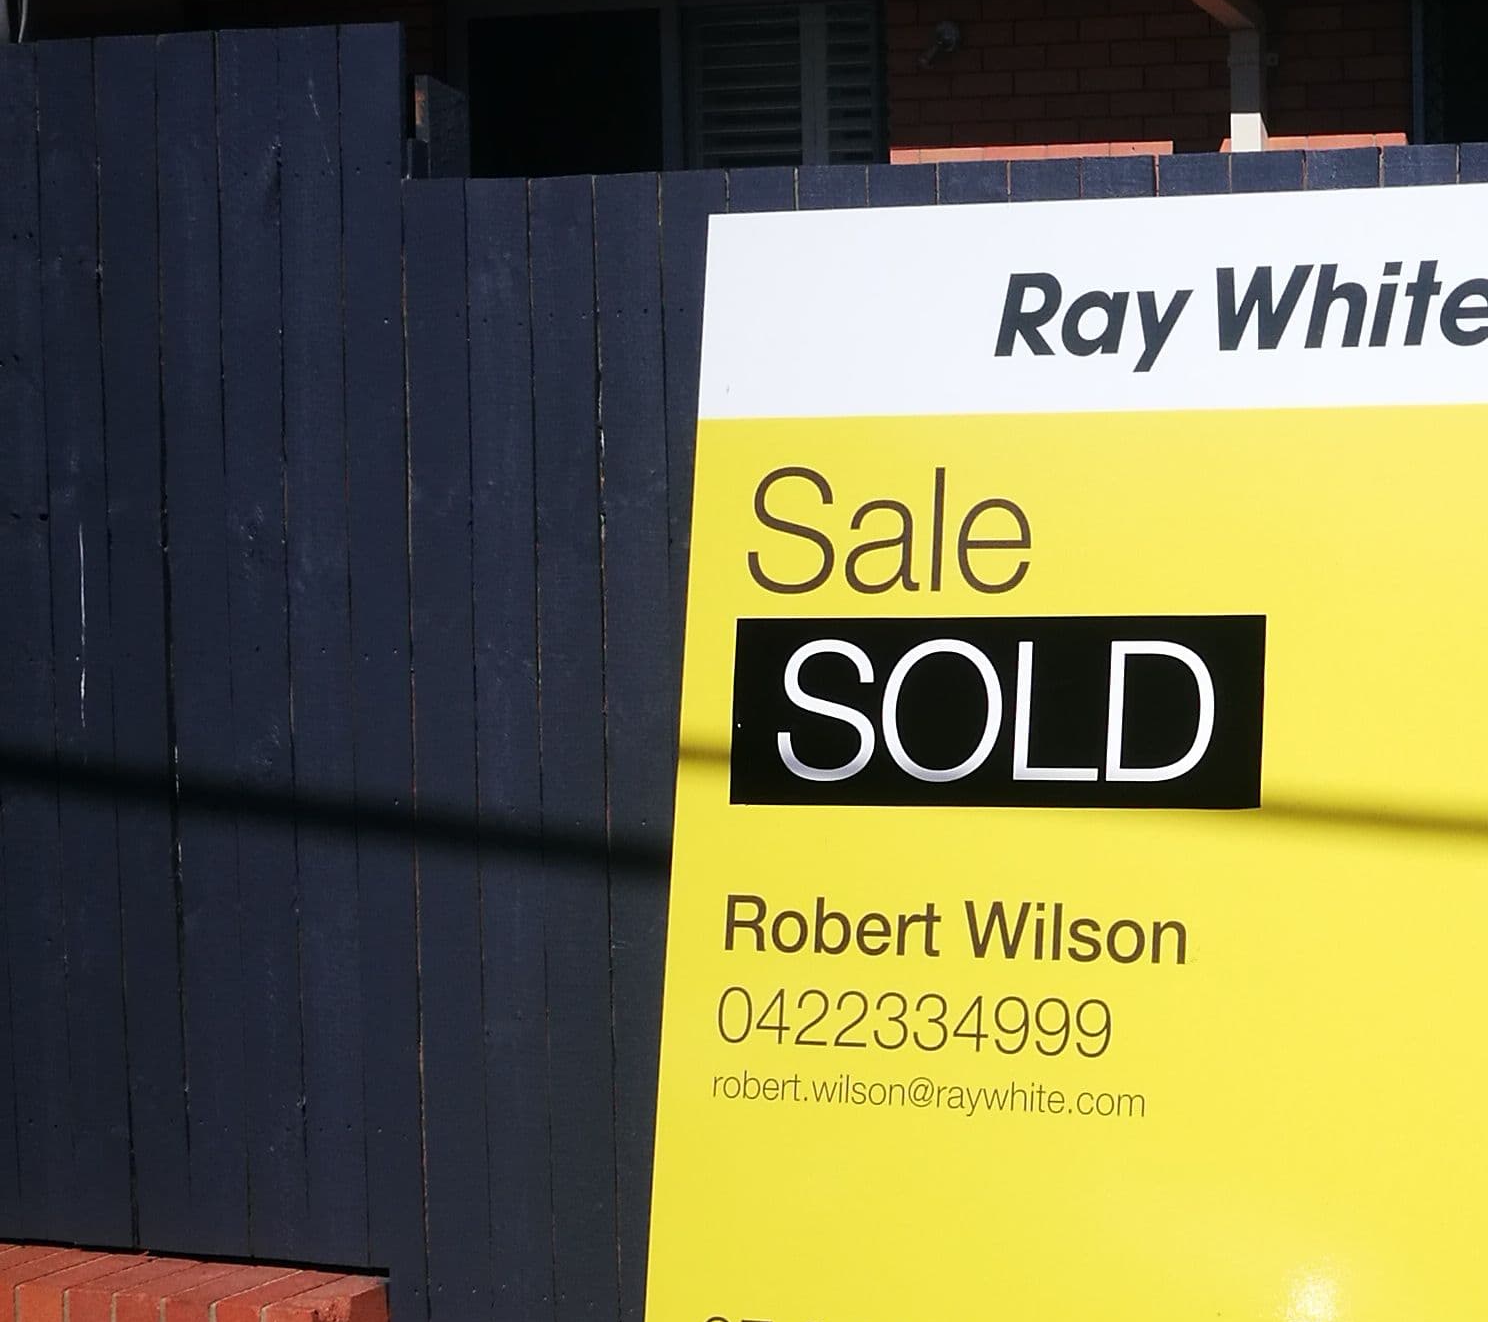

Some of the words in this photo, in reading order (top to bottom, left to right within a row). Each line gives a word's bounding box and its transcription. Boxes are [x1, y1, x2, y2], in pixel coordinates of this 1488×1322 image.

[993, 272, 1194, 373] Ray
[747, 466, 1032, 595] Sale
[777, 638, 1215, 783] SOLD
[724, 894, 942, 958] Robert
[964, 900, 1187, 965] Wilson
[718, 986, 1112, 1058] 0422334999
[712, 1069, 1145, 1118] robert.wilson@raywhite.com
